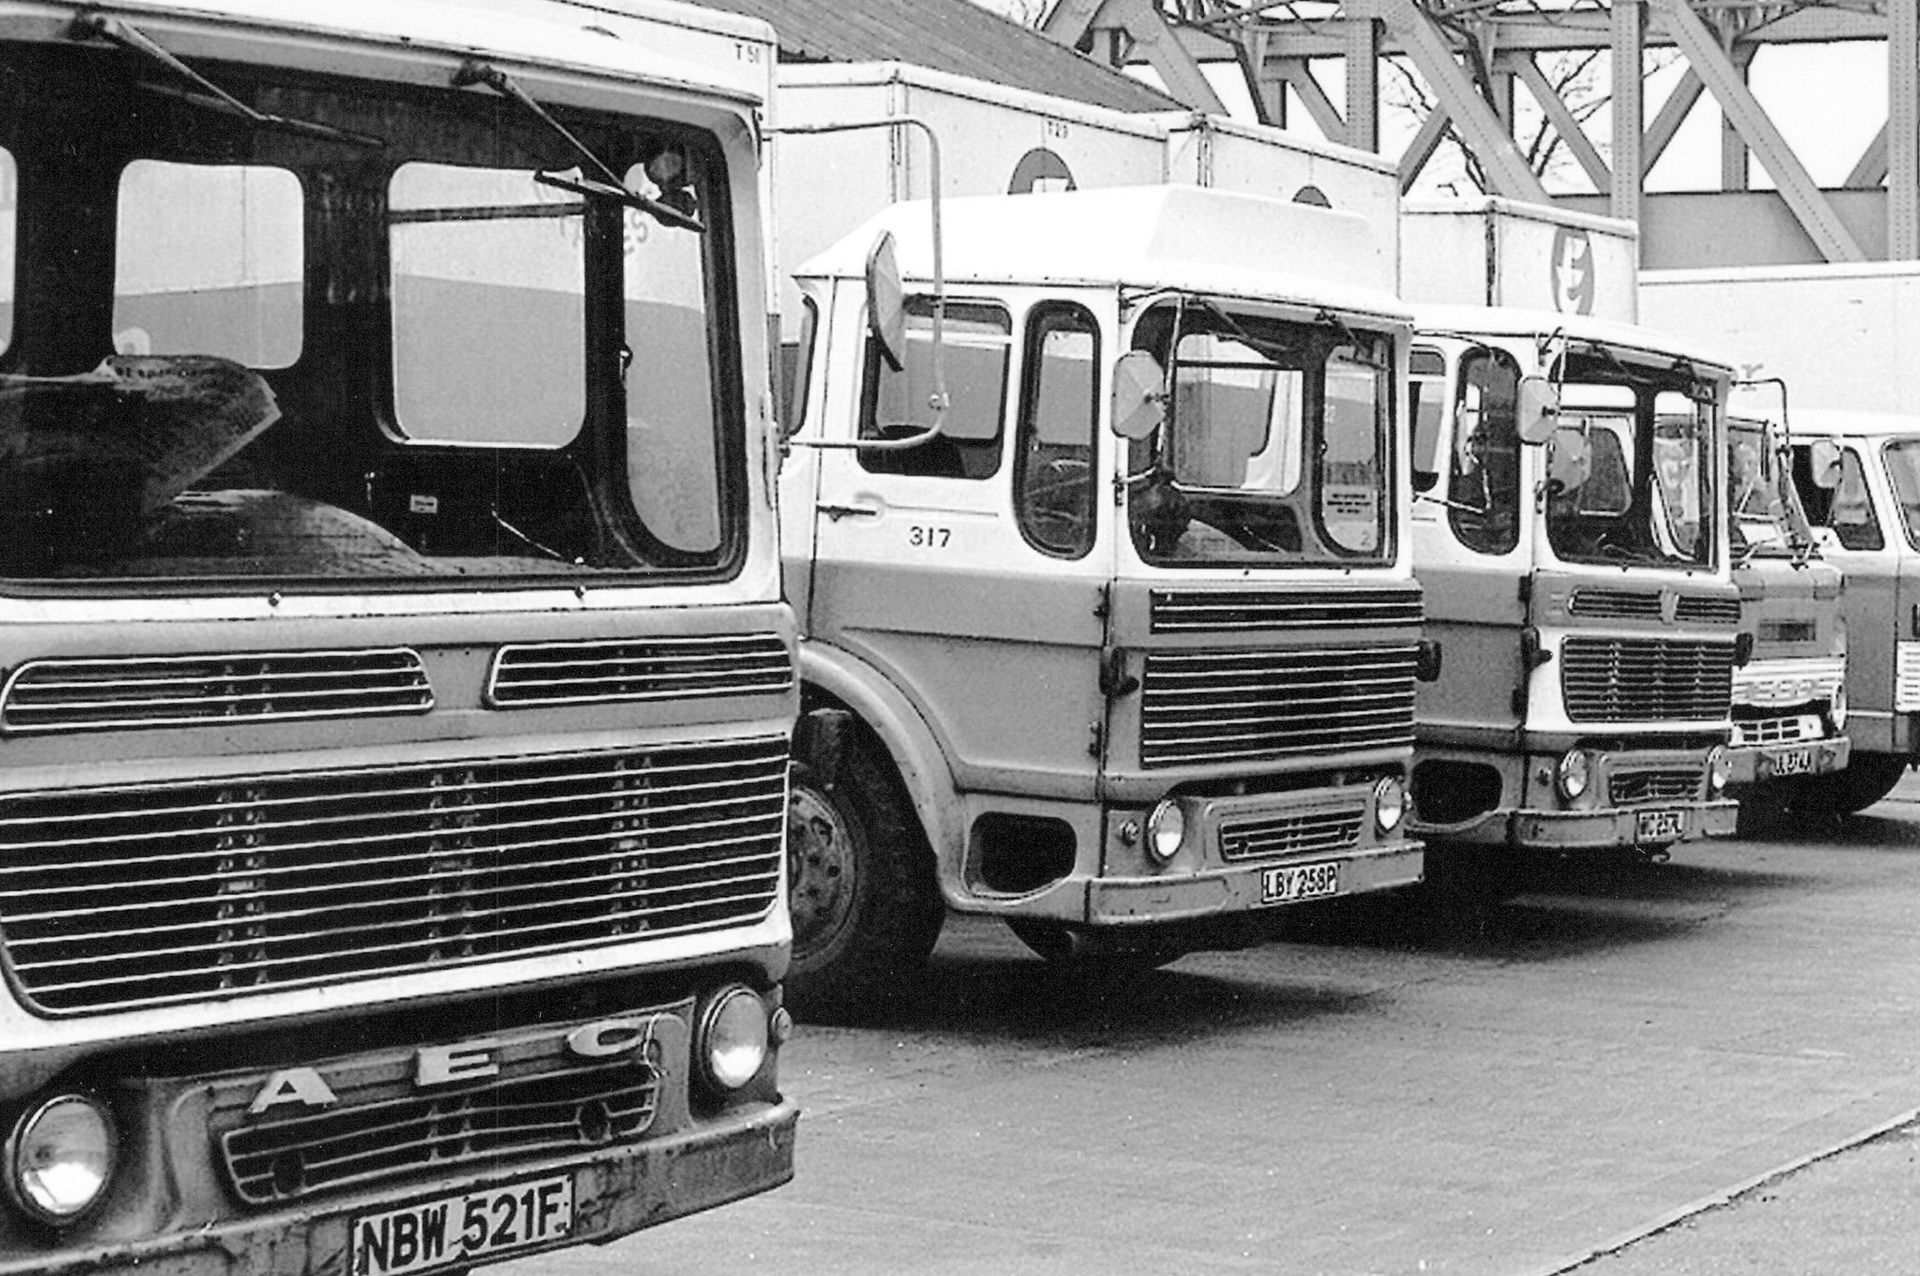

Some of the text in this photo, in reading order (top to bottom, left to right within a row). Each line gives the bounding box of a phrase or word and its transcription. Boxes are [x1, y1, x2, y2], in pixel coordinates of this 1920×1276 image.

[909, 525, 952, 548] 317
[1265, 864, 1336, 898] LBY 258P
[250, 1018, 644, 1114] AEC
[361, 1181, 565, 1276] NBW 521F
